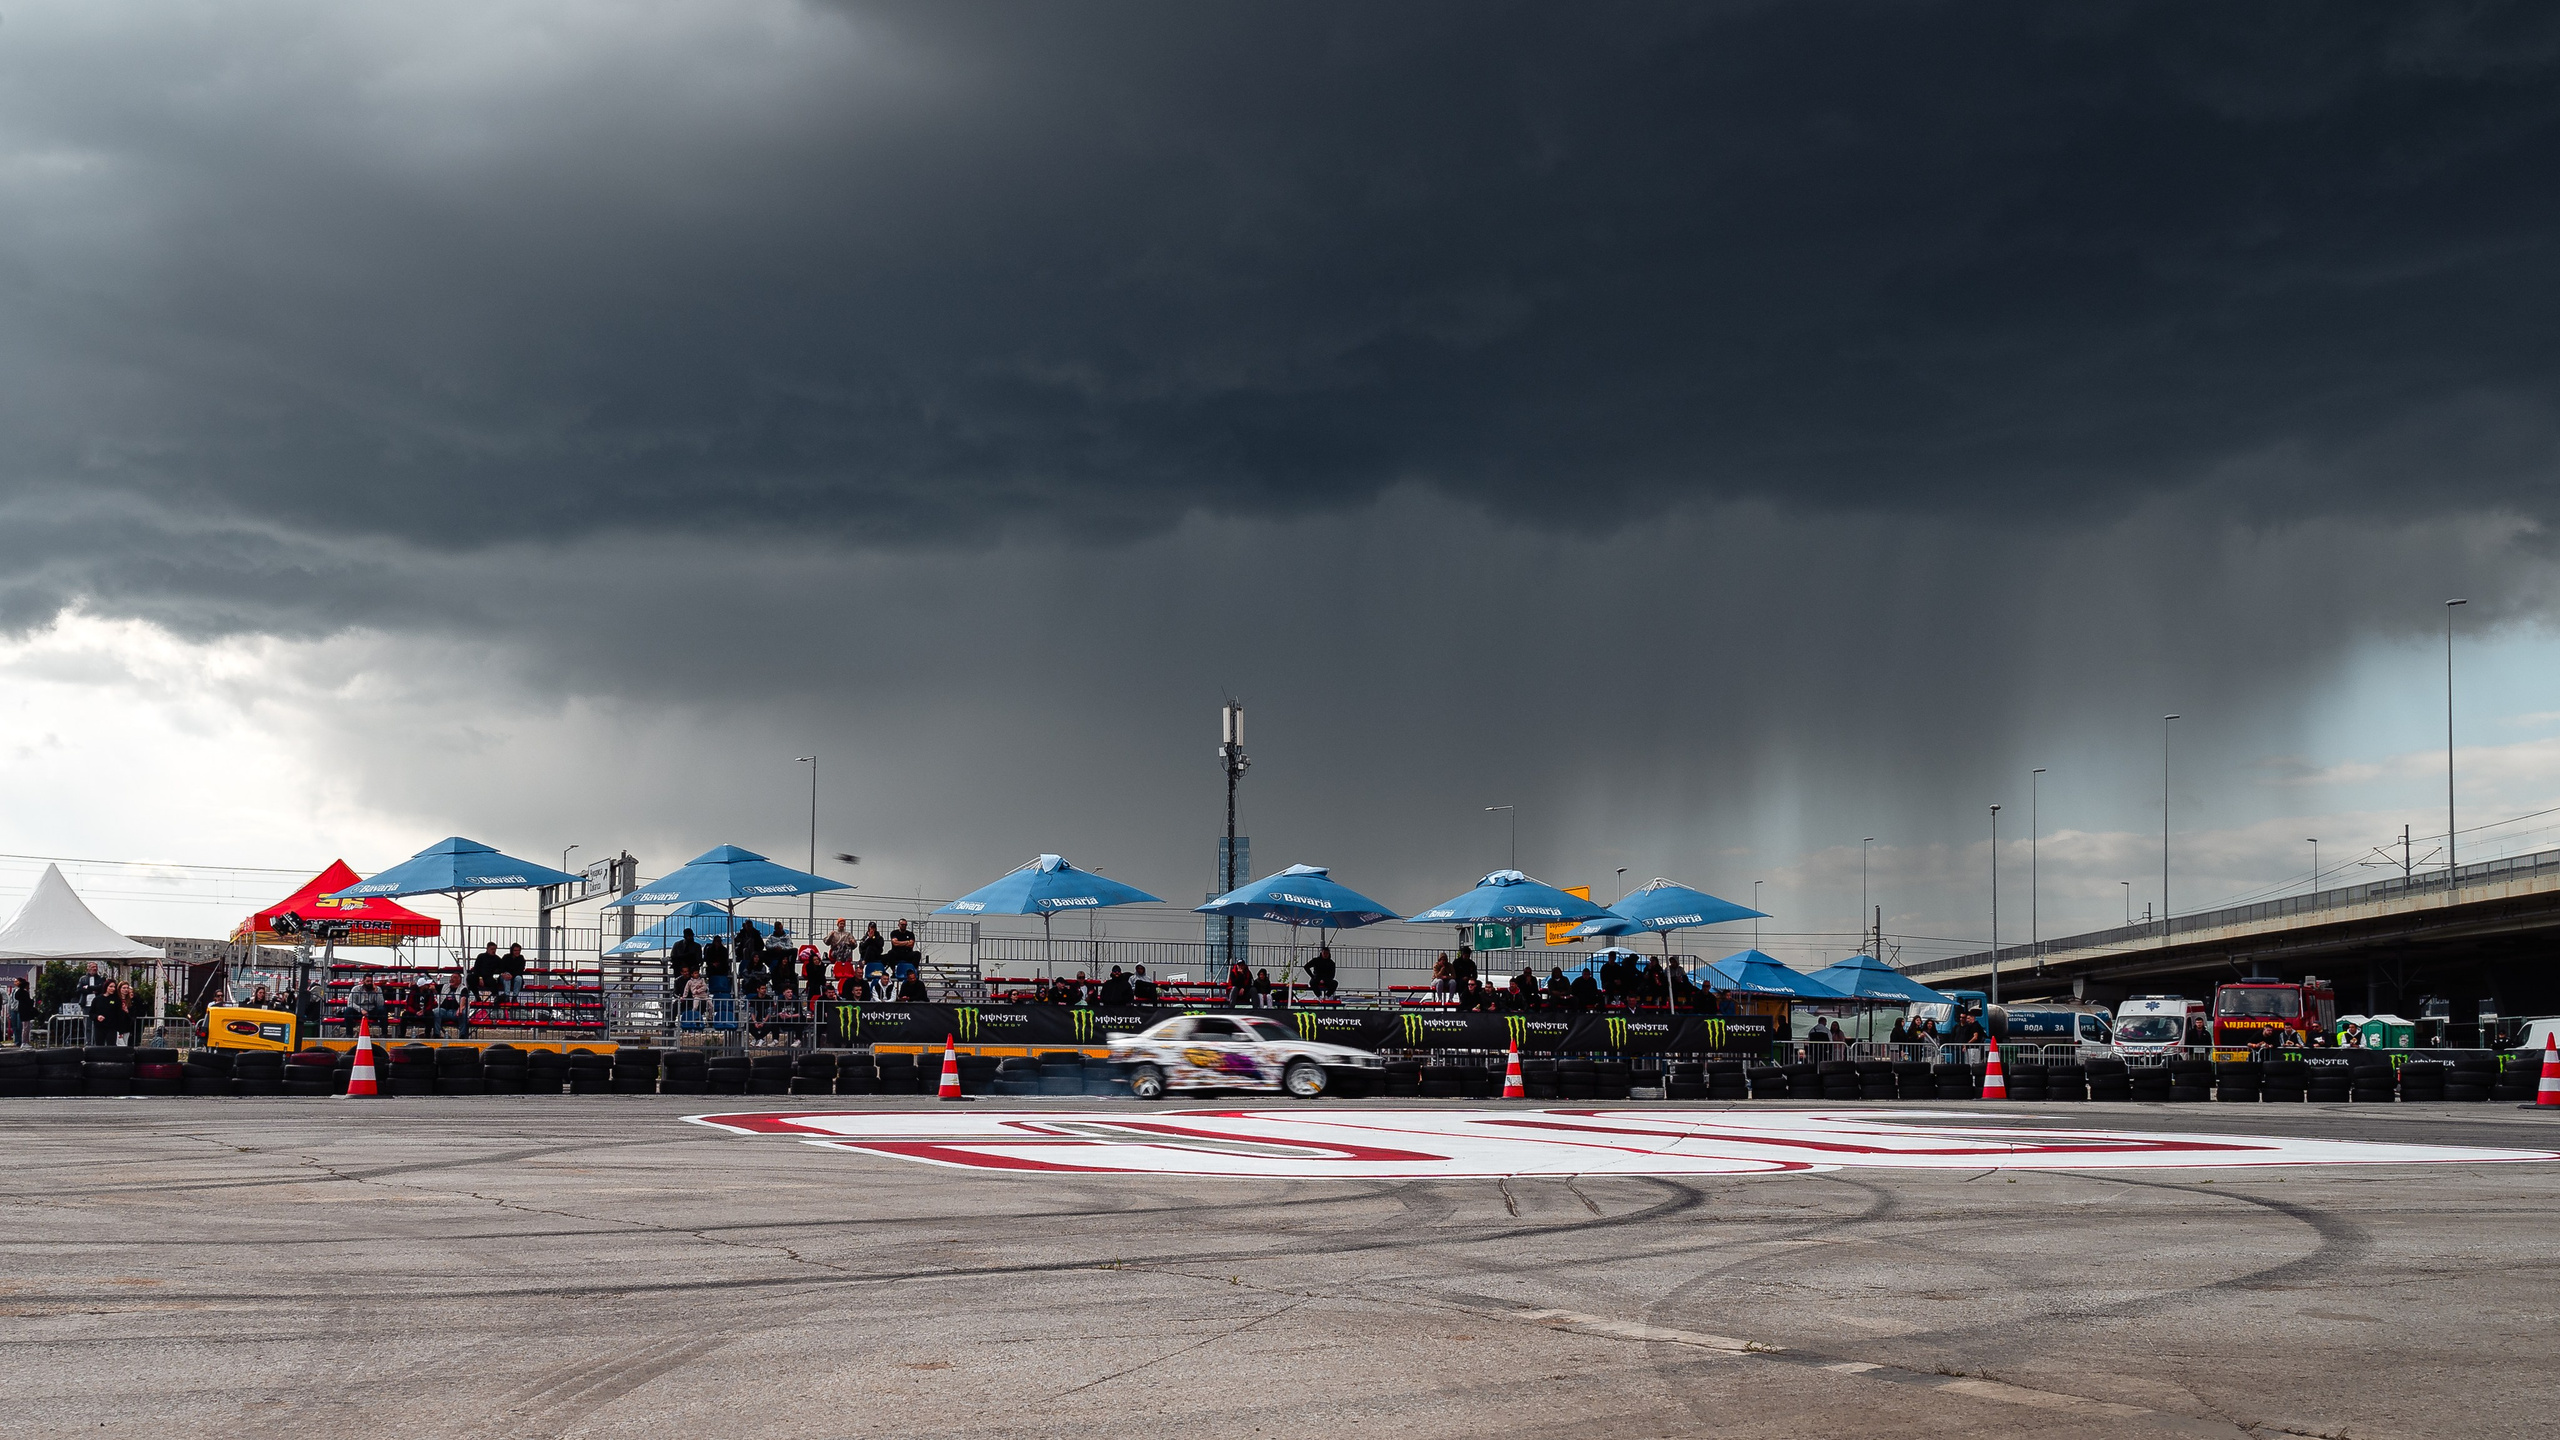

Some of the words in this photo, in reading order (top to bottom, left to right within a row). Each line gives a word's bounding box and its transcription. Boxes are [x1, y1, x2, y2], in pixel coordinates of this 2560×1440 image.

[479, 875, 527, 884] Bavaria
[359, 883, 400, 893] Bavaria
[754, 884, 798, 894] Bavaria
[639, 891, 679, 901] Bavaria
[1283, 893, 1332, 909] Bavaria
[1050, 896, 1099, 907] Bavaria
[1516, 905, 1562, 916] Bavaria
[1654, 913, 1703, 926] Bavaria
